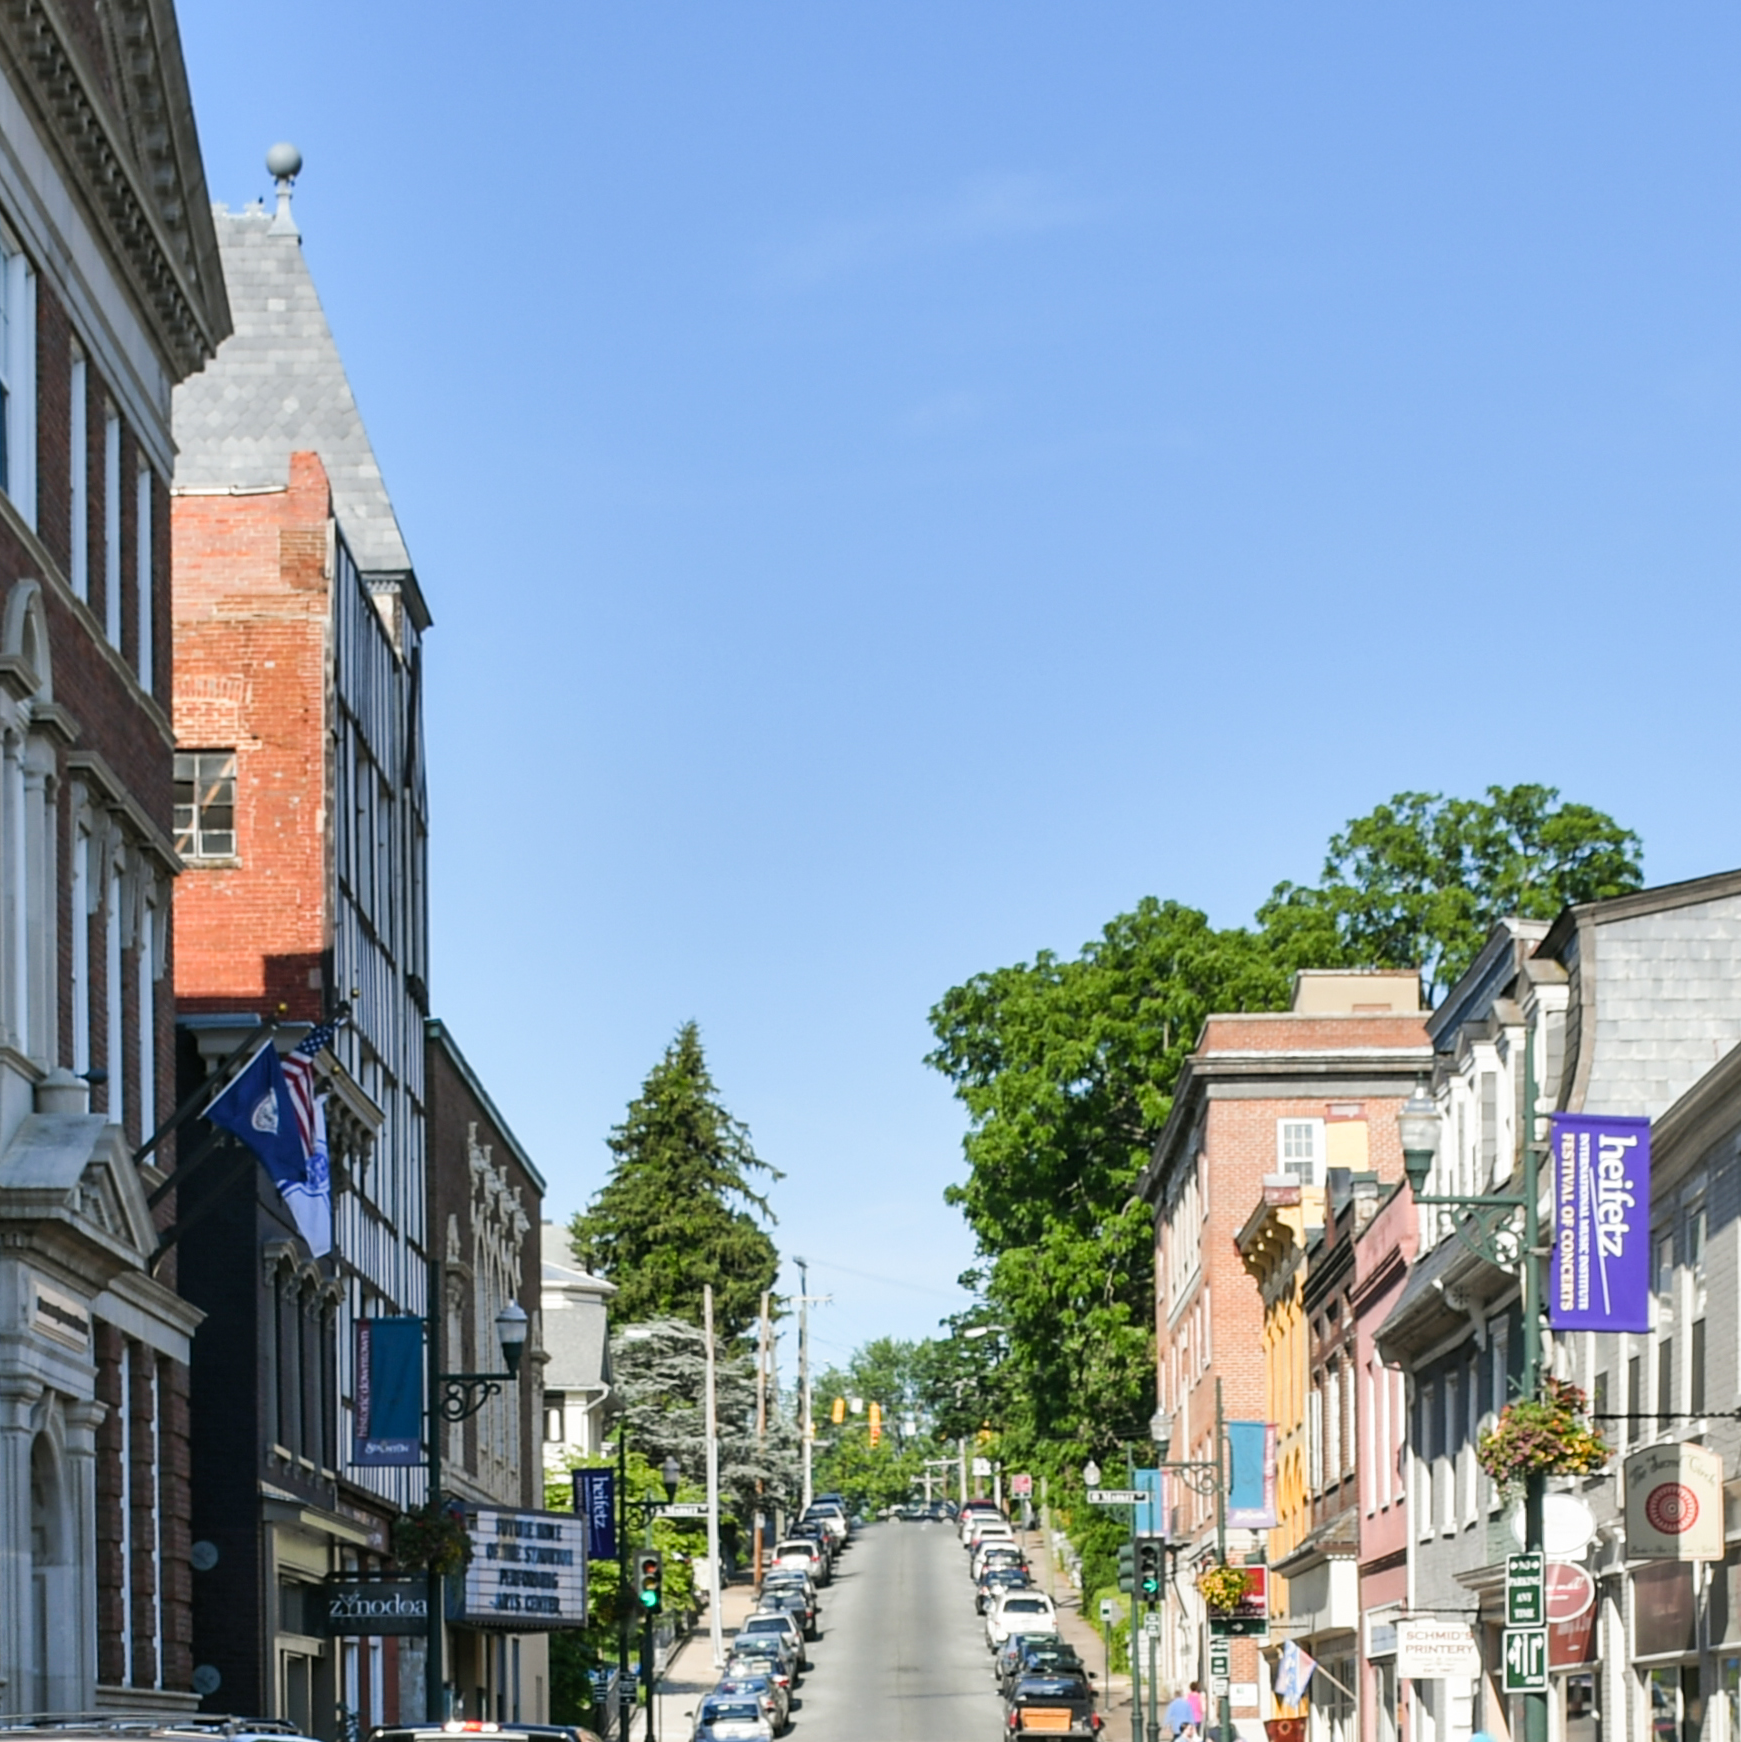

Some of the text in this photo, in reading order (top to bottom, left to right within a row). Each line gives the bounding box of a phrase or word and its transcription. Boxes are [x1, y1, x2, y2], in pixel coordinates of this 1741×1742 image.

[1560, 1132, 1575, 1312] FESTIVAL OF CONCERTS
[1577, 1132, 1590, 1311] INTERNATIONAL MUSIC INSTITUTE
[1597, 1133, 1638, 1258] heifetz
[592, 1476, 611, 1529] heifetz
[1405, 1645, 1474, 1654] PRINTERY
[1406, 1631, 1474, 1641] SCHMID'S
